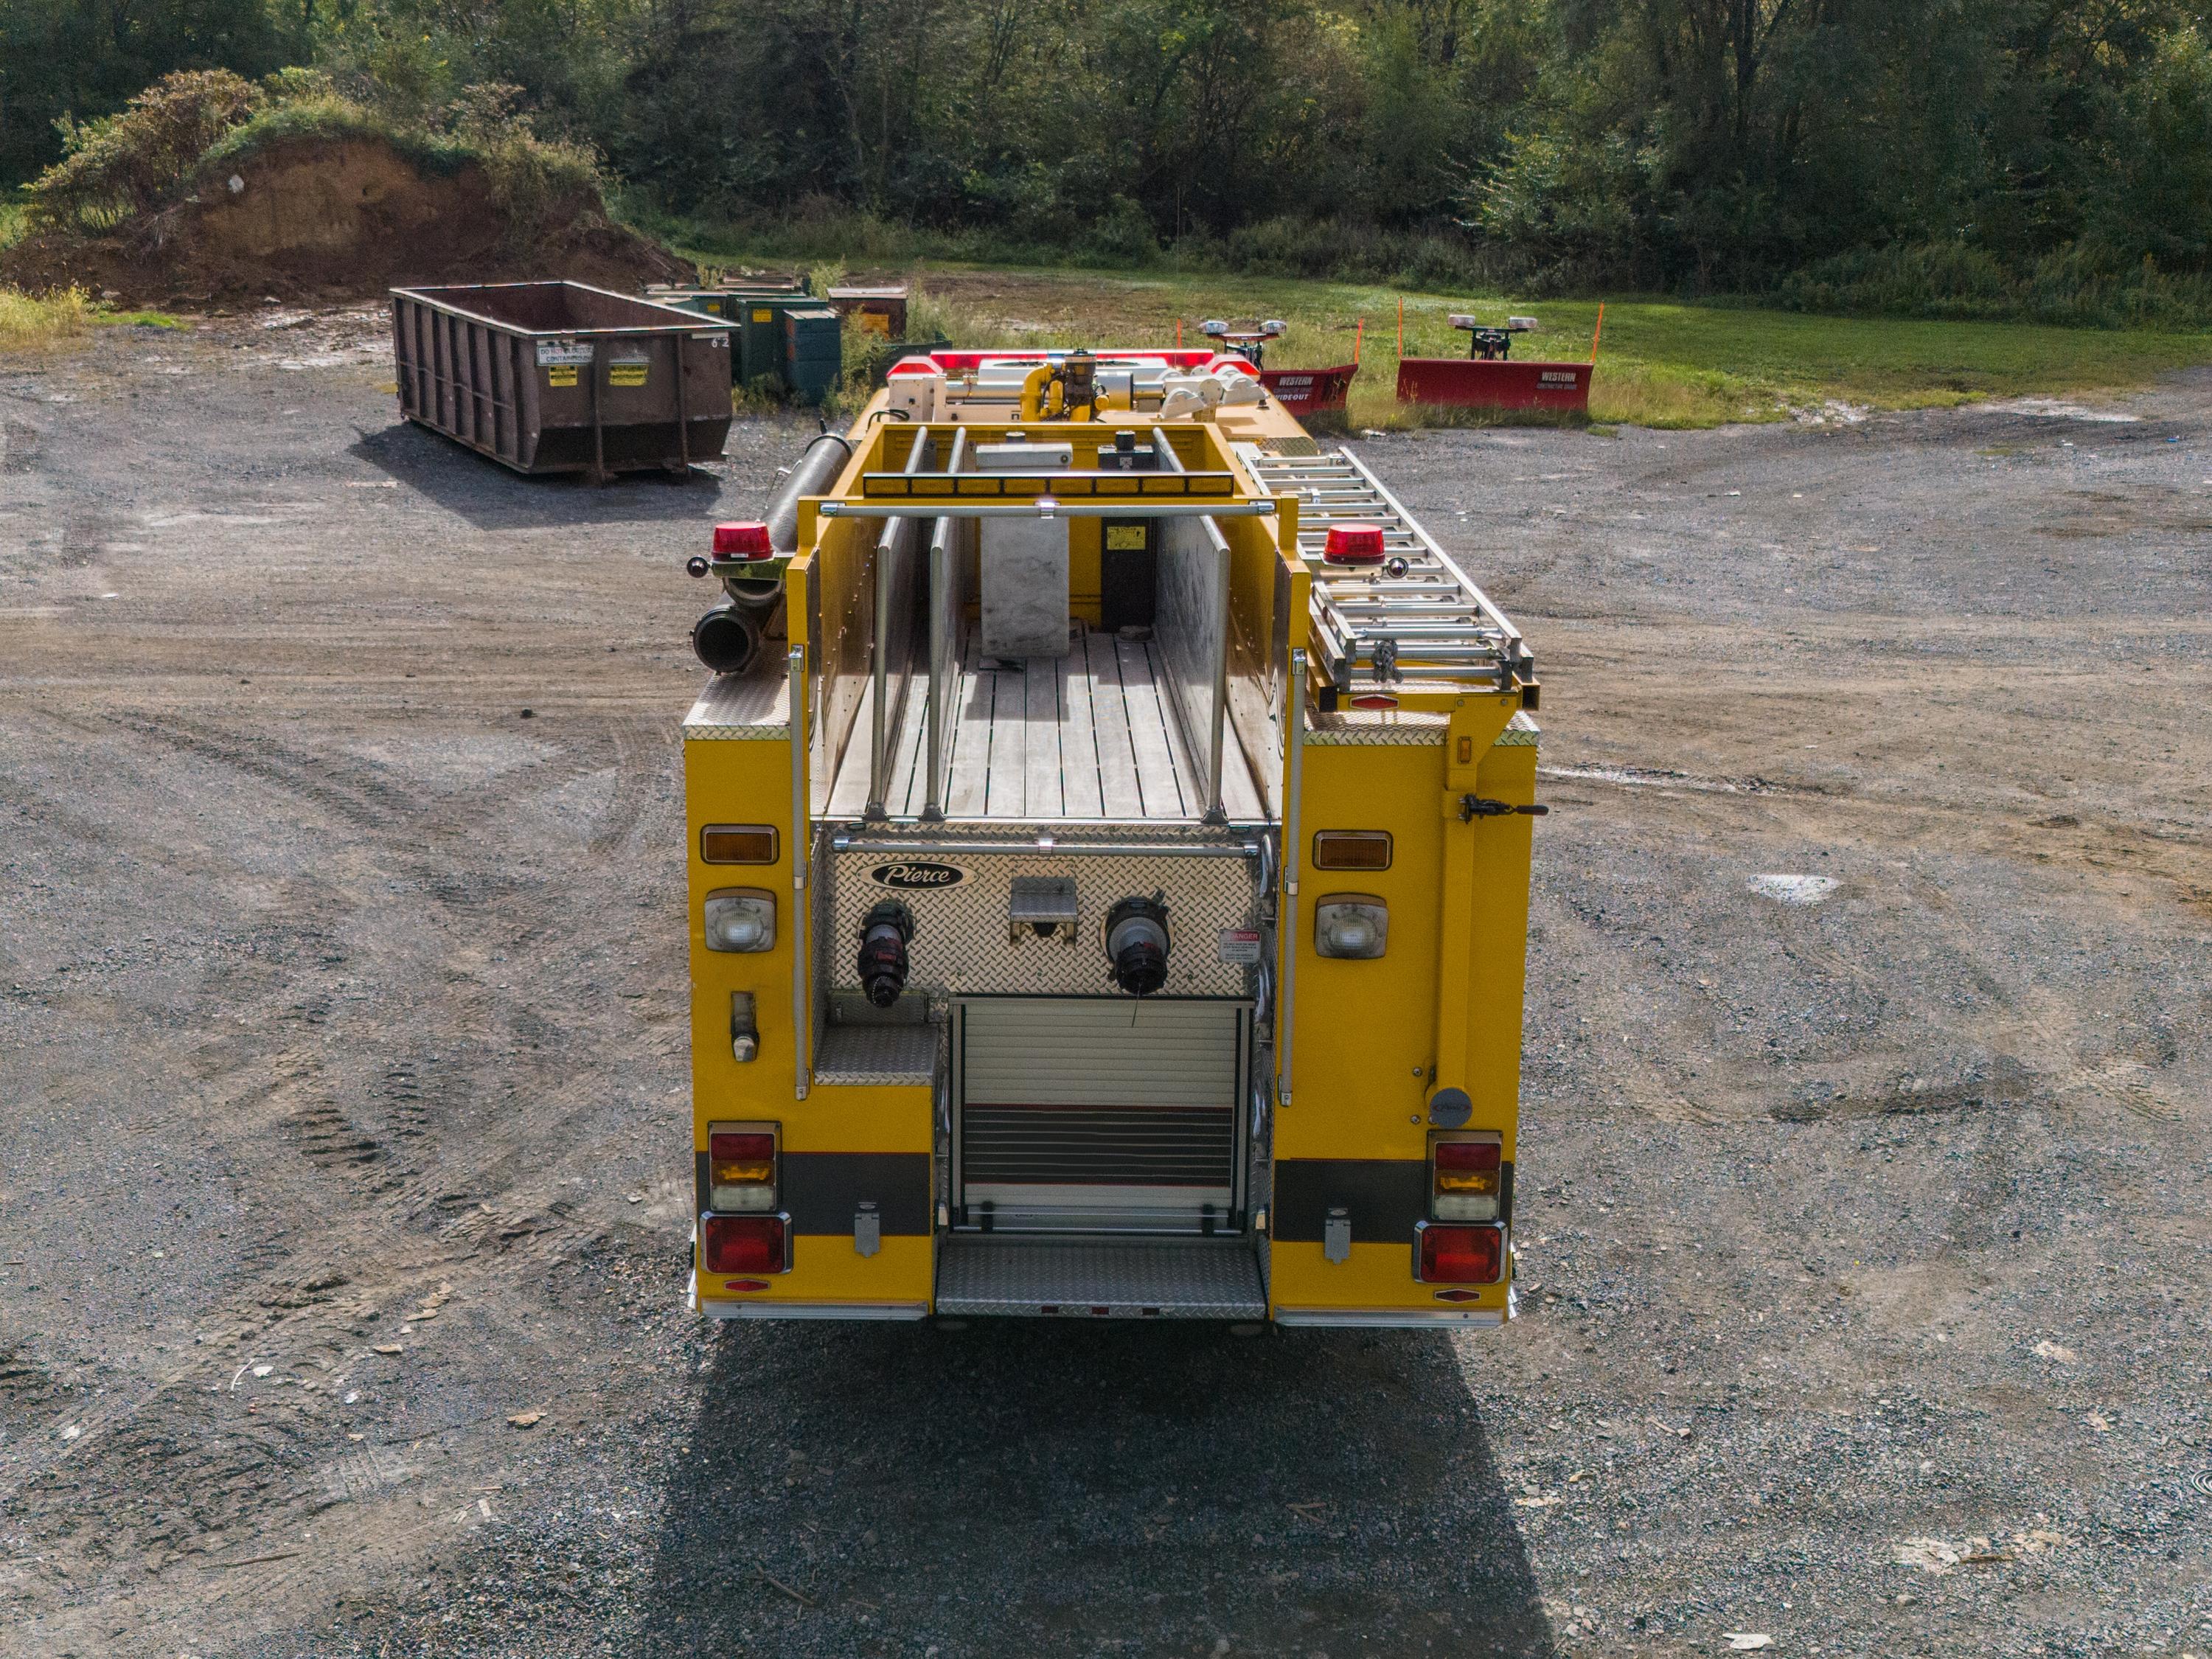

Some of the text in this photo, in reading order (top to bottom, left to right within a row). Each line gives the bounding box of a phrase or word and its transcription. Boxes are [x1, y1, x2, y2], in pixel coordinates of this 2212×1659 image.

[1279, 377, 1314, 386] WESTERN
[1542, 372, 1576, 382] WESTERN
[883, 865, 950, 885] Pierce
